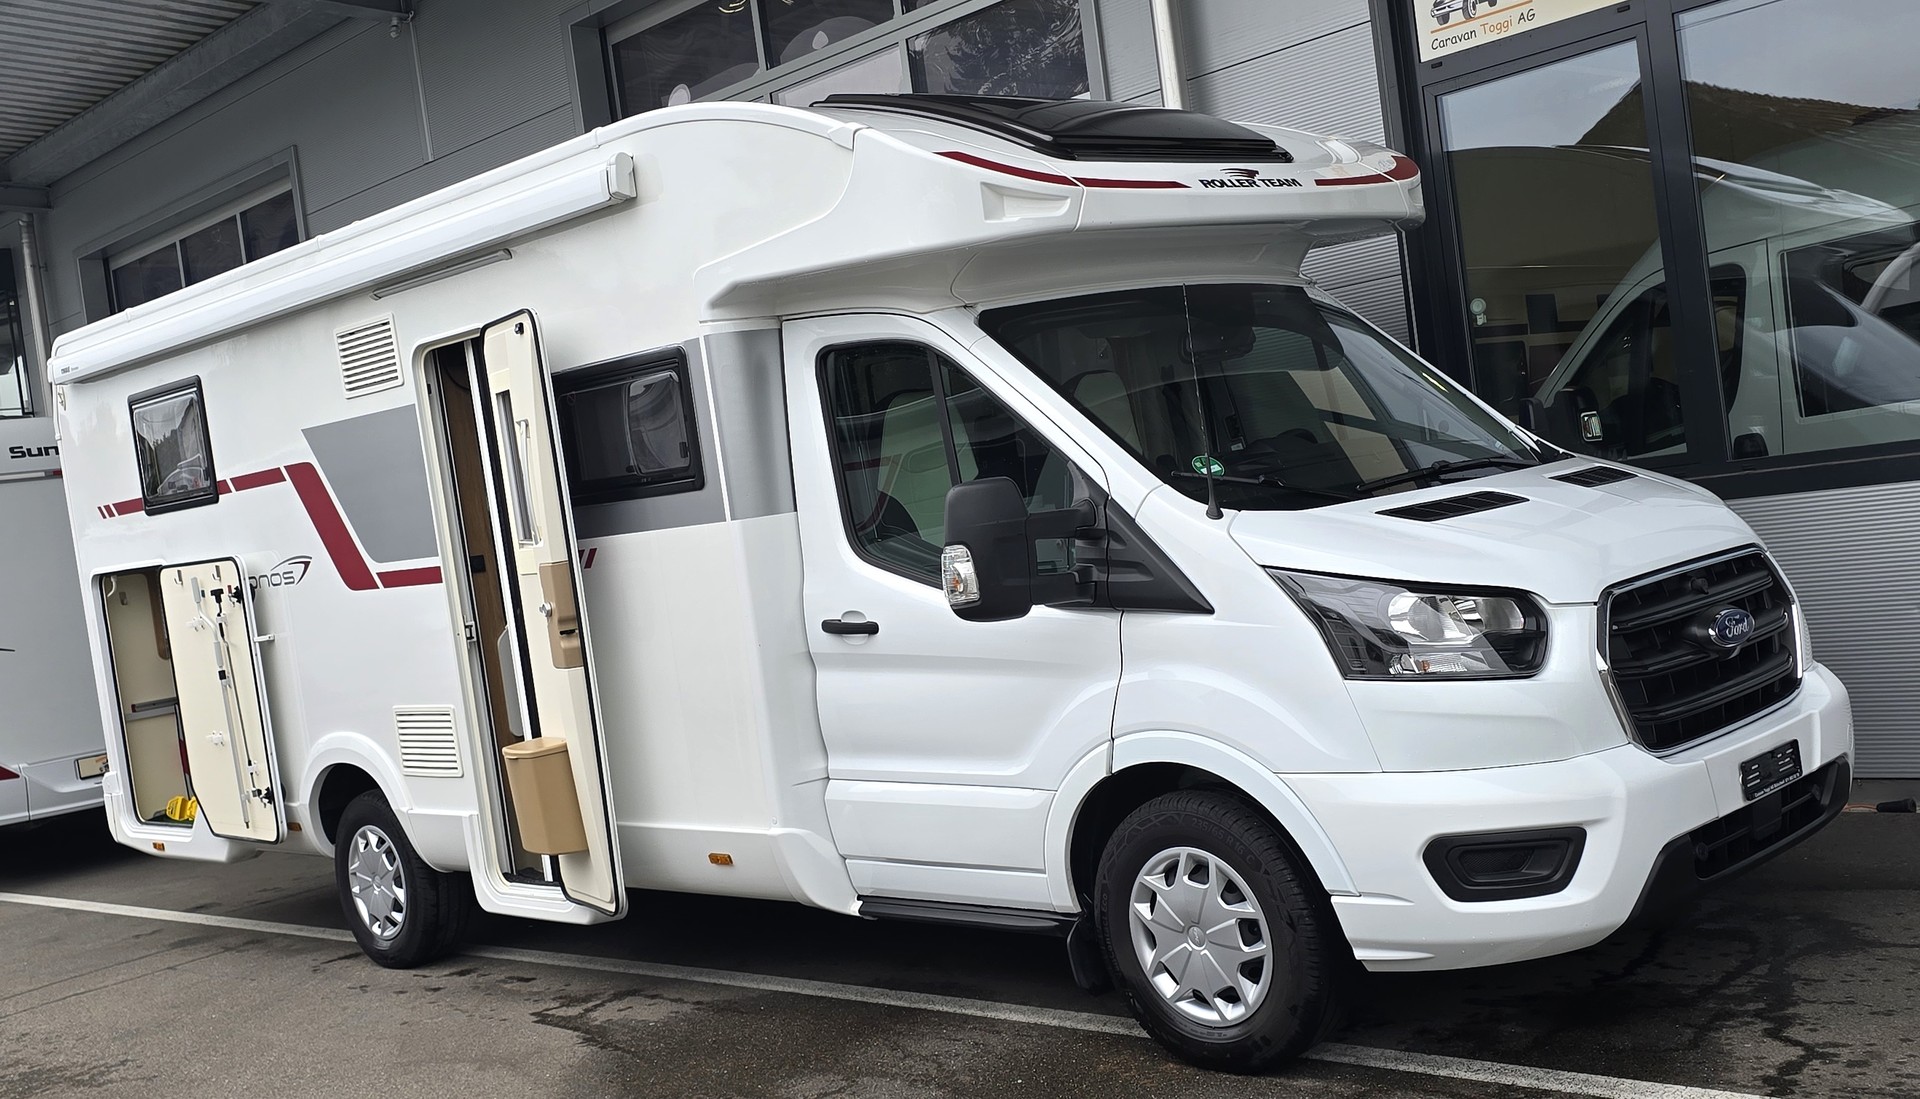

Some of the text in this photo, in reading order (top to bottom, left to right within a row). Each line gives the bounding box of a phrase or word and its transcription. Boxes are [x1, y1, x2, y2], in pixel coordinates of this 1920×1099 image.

[1431, 8, 1536, 51] Caravan Toggi AG
[1198, 178, 1303, 189] ROLLER TEAM
[9, 445, 60, 459] Sun
[1725, 614, 1750, 638] Ford
[1192, 817, 1255, 865] 235/65 R 16 C
